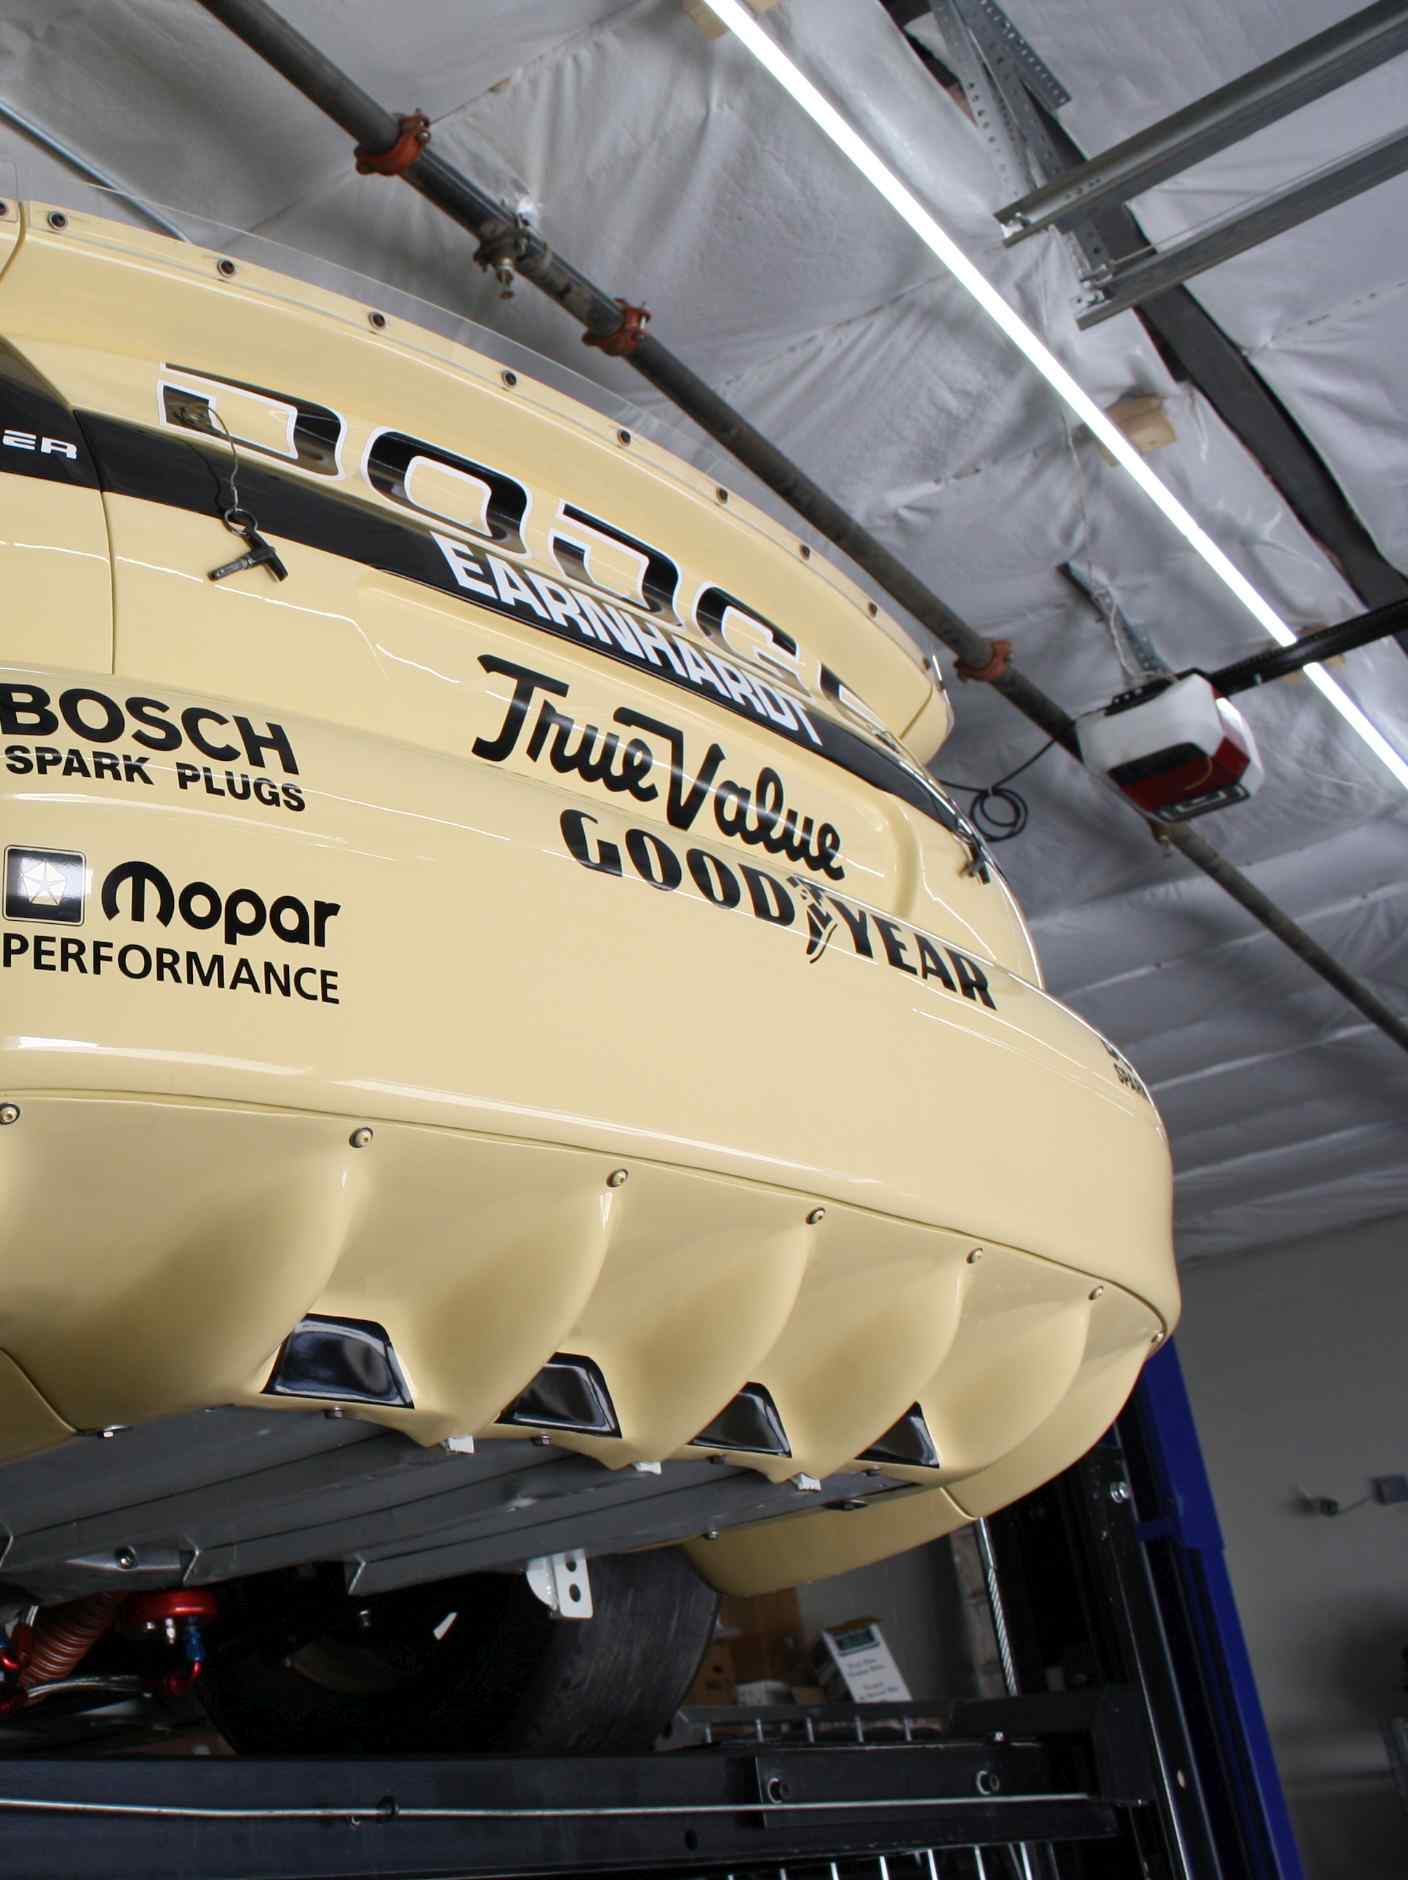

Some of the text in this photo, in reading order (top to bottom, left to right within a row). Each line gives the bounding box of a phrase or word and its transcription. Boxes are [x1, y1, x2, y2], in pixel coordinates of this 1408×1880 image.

[429, 532, 823, 747] EARNHARDT
[4, 745, 306, 812] SPARK PLUGS
[2, 932, 341, 1005] PERFORMANCE
